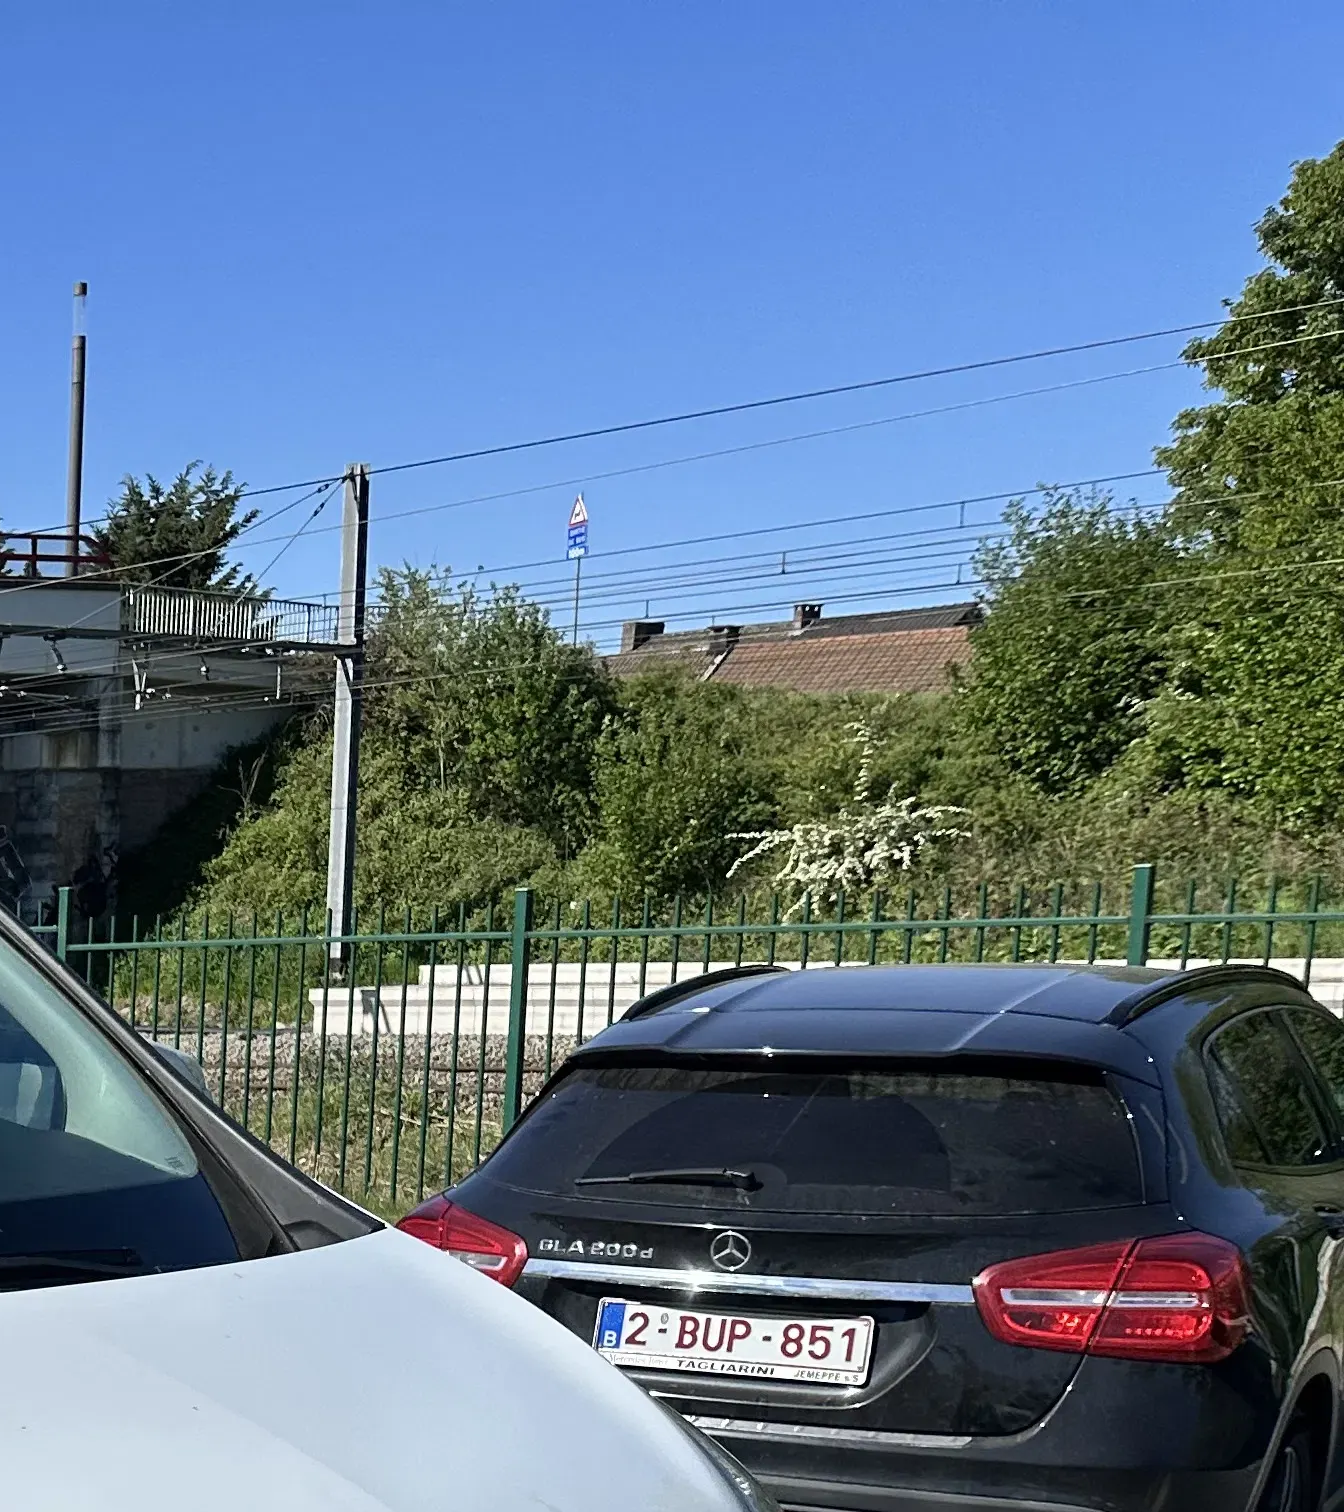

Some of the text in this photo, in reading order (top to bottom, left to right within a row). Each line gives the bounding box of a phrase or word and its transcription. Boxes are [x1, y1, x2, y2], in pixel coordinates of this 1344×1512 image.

[539, 1239, 584, 1255] GLA
[603, 1330, 617, 1347] B
[676, 1360, 775, 1376] TAGLIARINI
[793, 1369, 841, 1382] JEMEPPE
